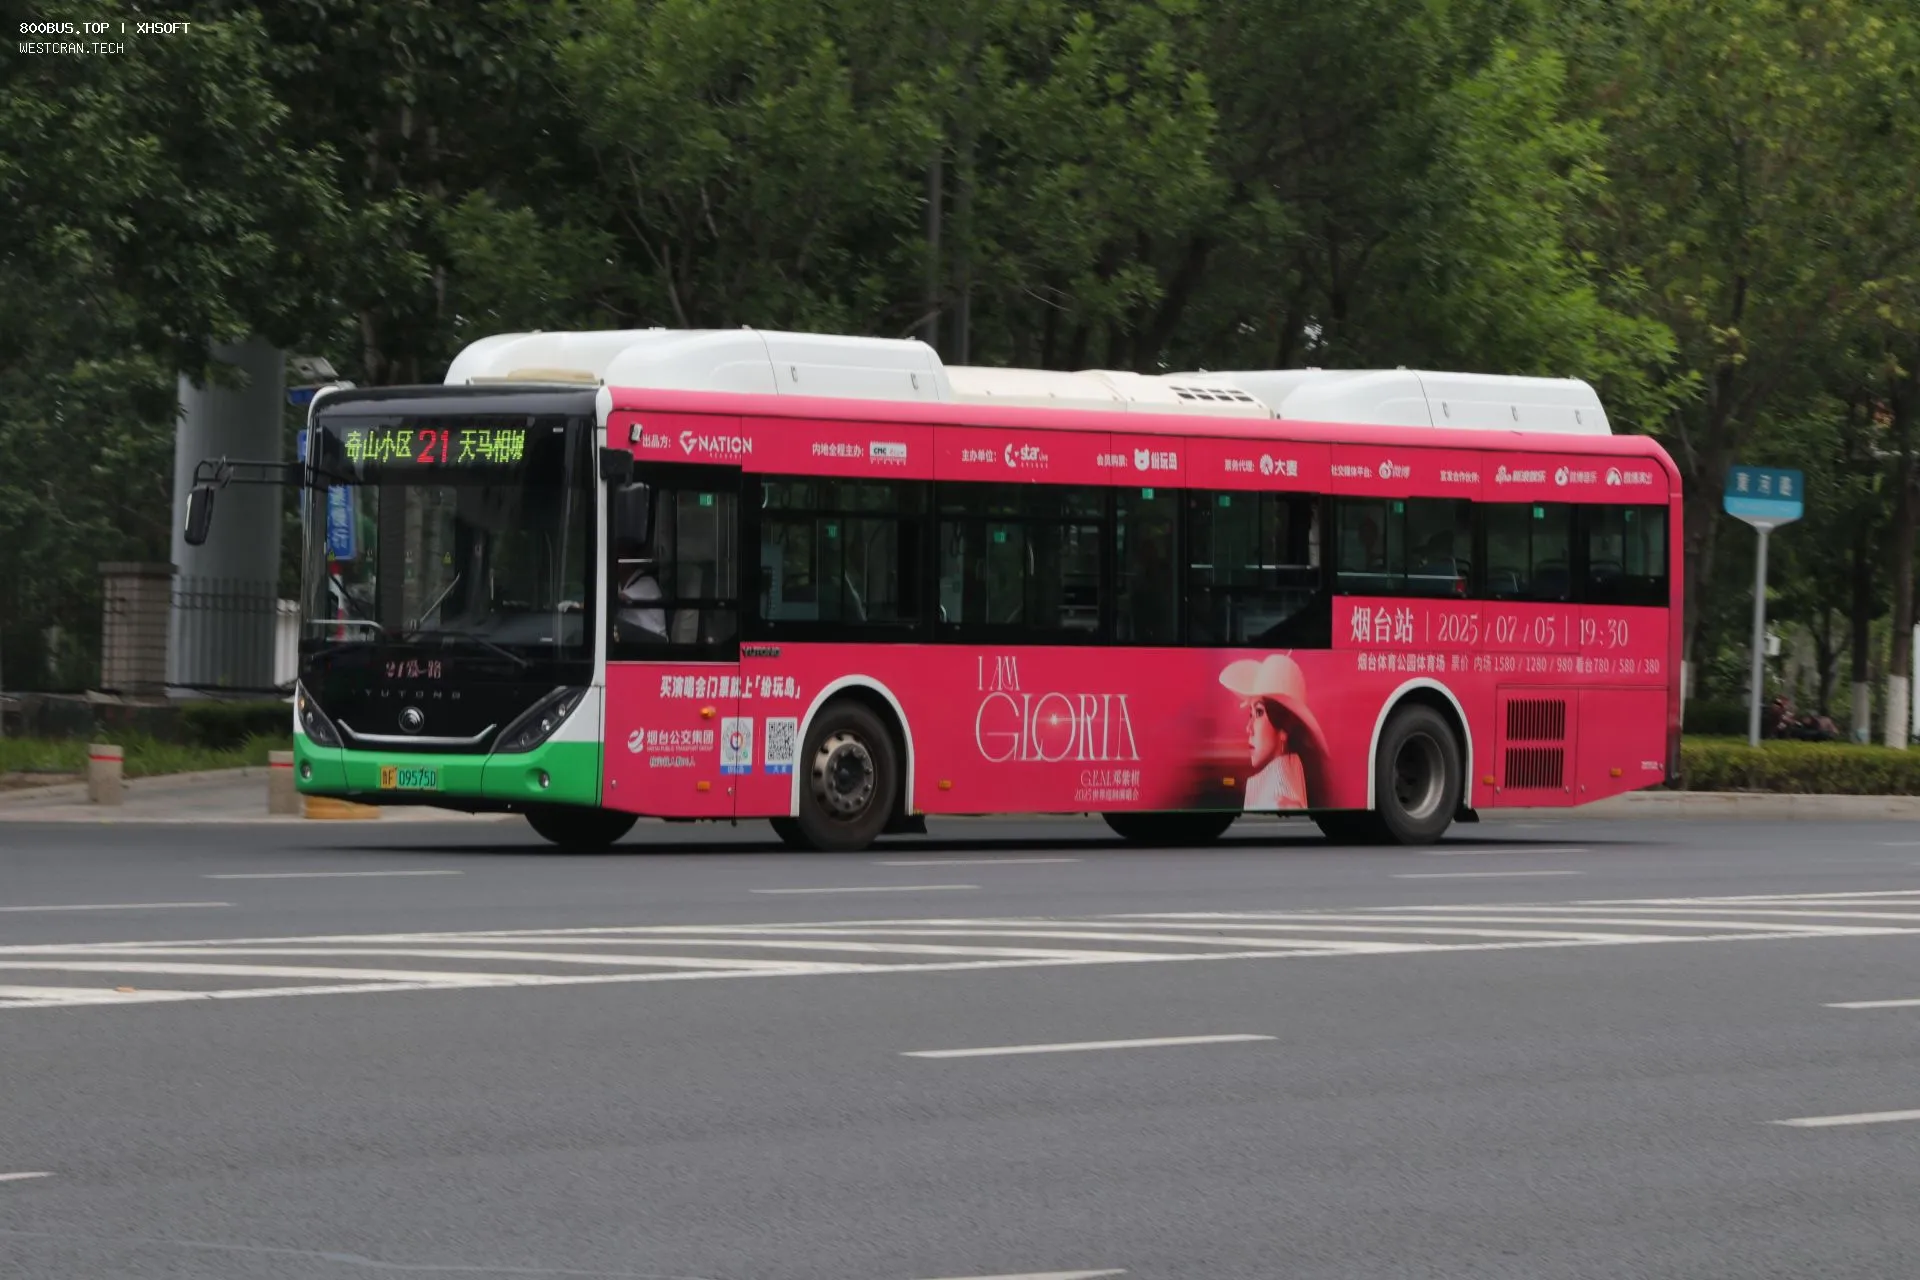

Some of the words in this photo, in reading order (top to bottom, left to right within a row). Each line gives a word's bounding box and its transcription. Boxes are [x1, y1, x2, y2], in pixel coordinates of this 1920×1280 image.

[344, 430, 414, 463] 奇山小区
[417, 430, 449, 463] 21
[1351, 606, 1414, 644] 烟台站
[1580, 618, 1629, 649] 19:30
[1358, 652, 1446, 672] 烟台体育公园体育场
[647, 730, 714, 745] 烟台公交集团
[975, 691, 1141, 763] GLORIA
